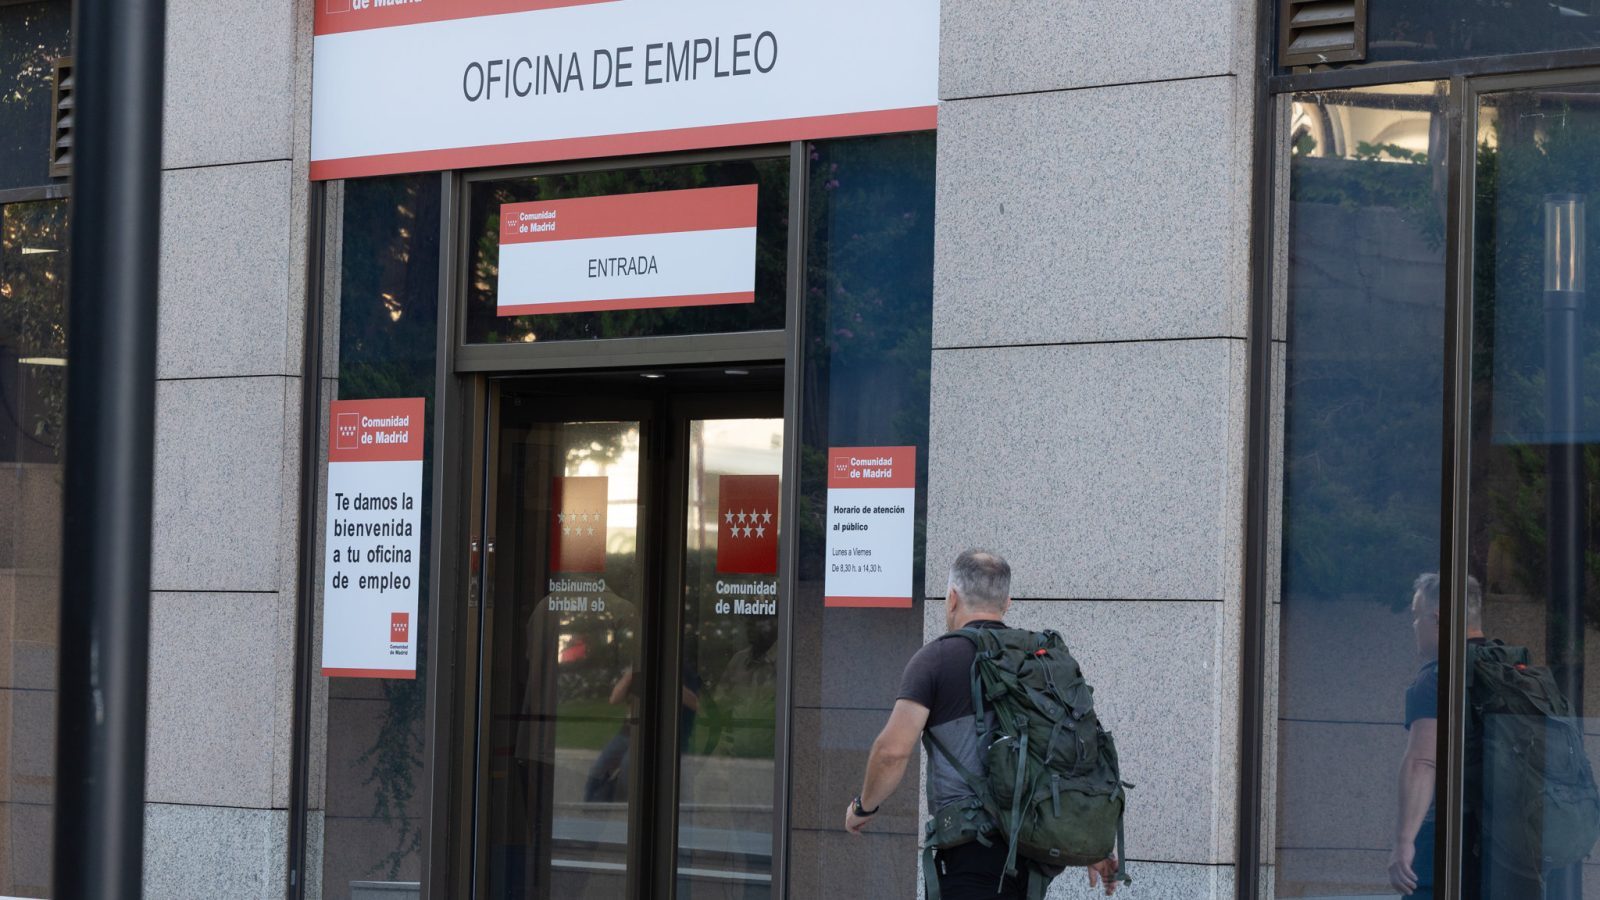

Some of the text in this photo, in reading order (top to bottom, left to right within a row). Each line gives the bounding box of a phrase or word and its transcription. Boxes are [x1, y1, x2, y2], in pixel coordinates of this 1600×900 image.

[463, 30, 778, 102] OFICINA DE EMPLEO
[519, 210, 556, 221] Comunidad
[519, 222, 556, 233] de Madrid
[588, 255, 658, 278] ENTRADA
[361, 415, 410, 428] Comunidad
[361, 431, 409, 445] de Madrid
[850, 456, 893, 467] Comunidad
[850, 468, 893, 479] de Madrid
[335, 492, 414, 511] Te damos la
[833, 505, 905, 514] Horario de atención
[334, 518, 413, 537] bienvenida
[833, 522, 869, 533] al público
[333, 544, 412, 563] a tu oficina
[832, 547, 848, 557] Lunes
[832, 563, 840, 572] De
[332, 571, 411, 594] de empleo
[715, 580, 777, 595] Comunidad
[715, 598, 777, 616] de Madrid
